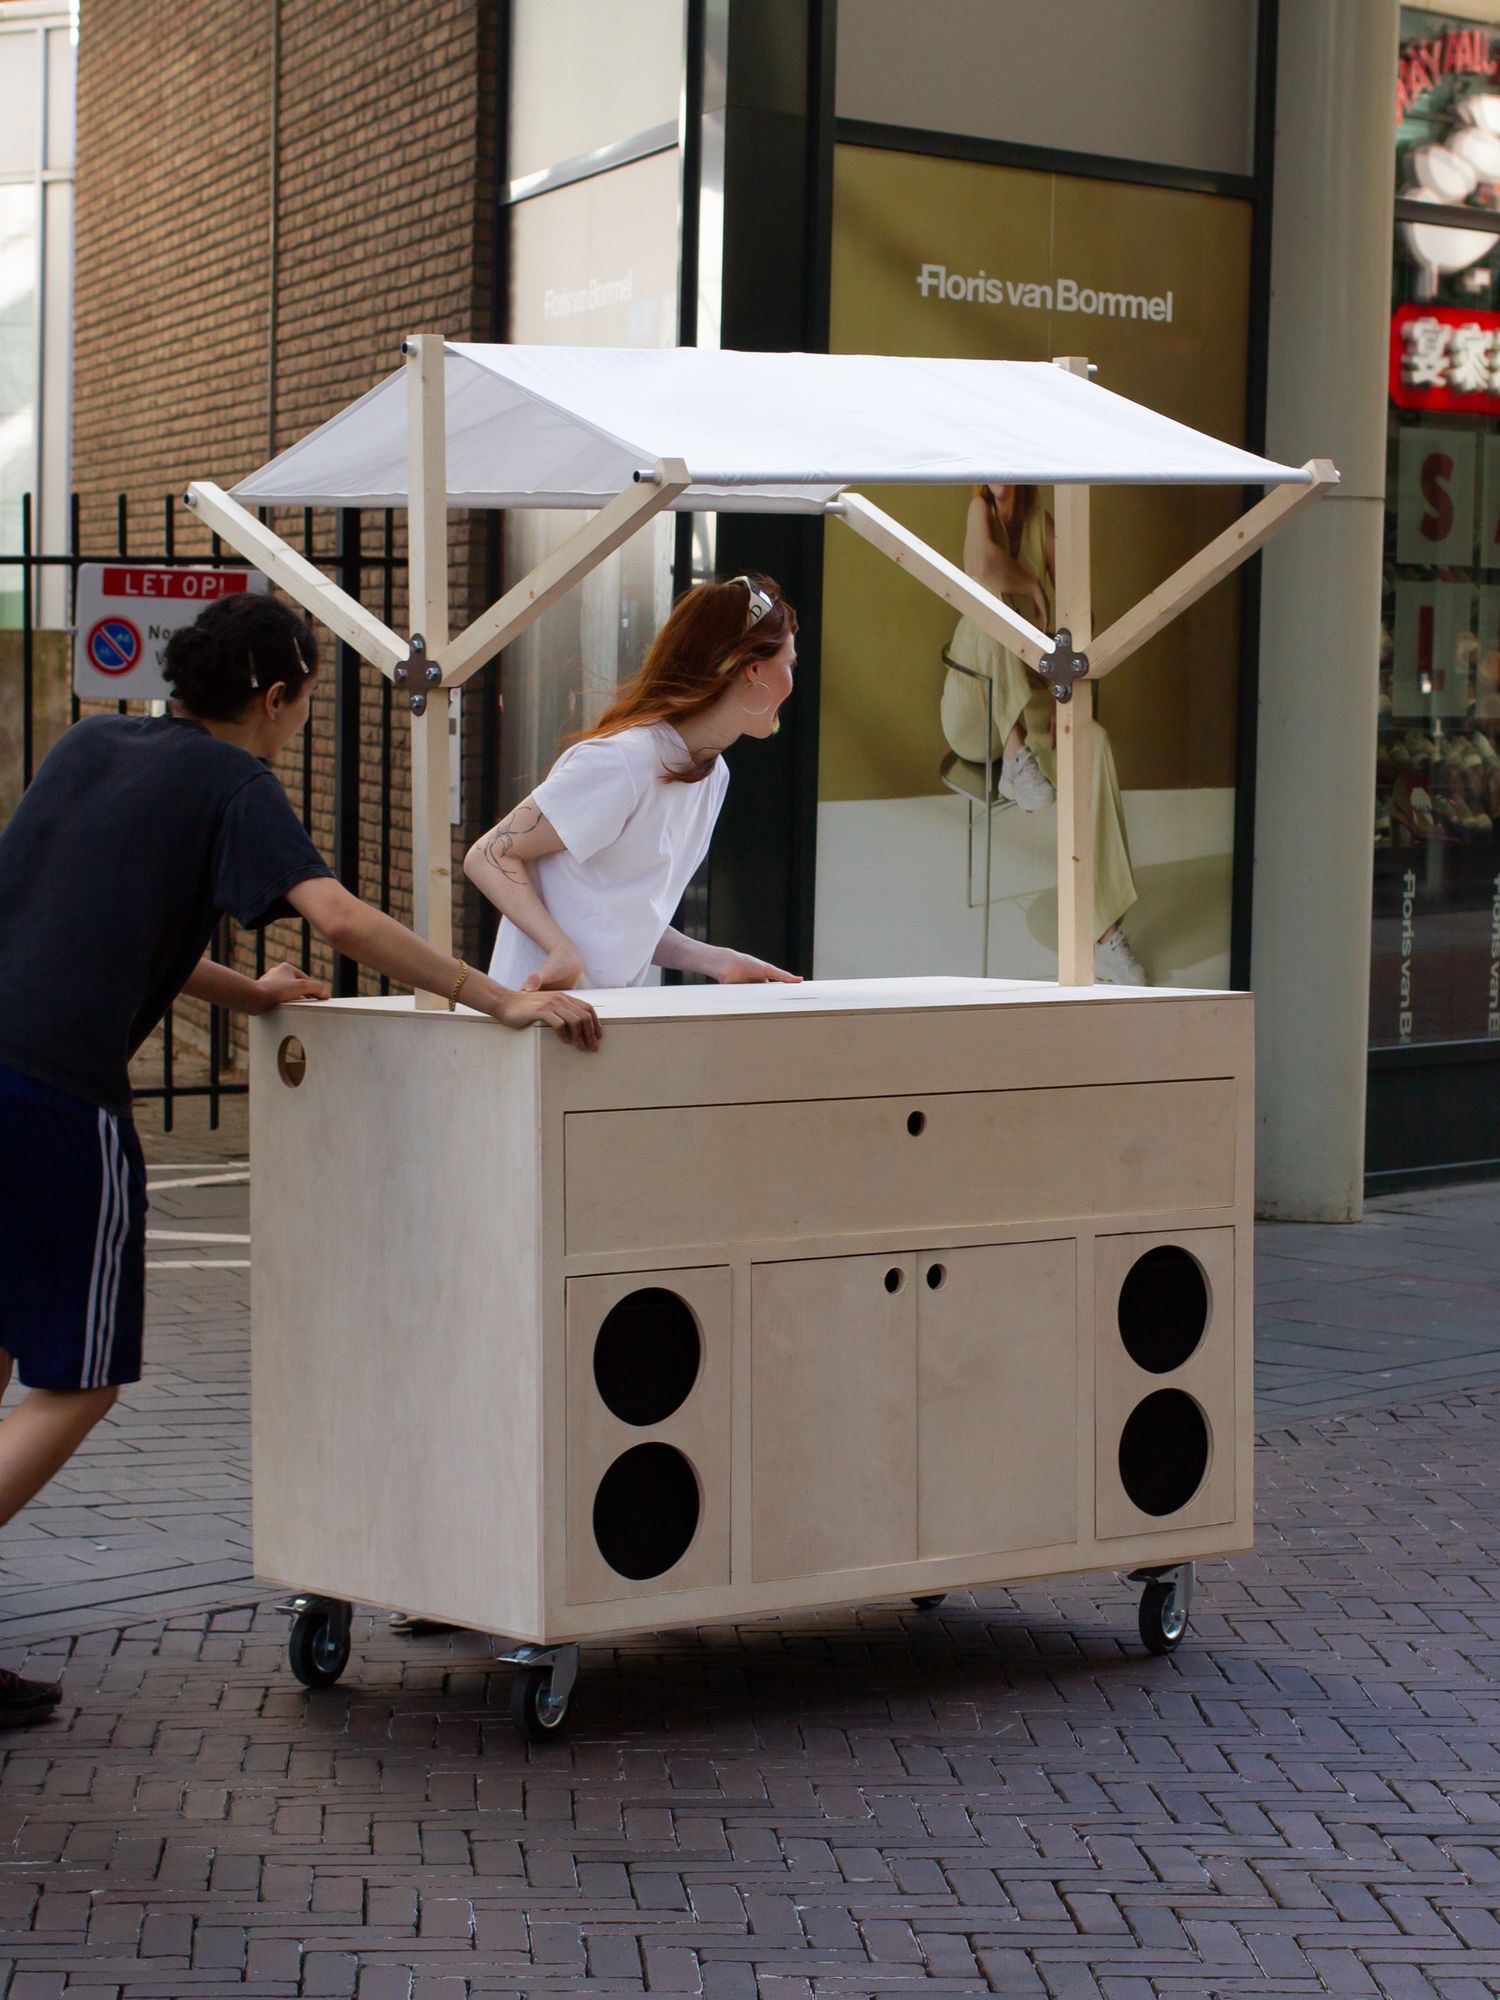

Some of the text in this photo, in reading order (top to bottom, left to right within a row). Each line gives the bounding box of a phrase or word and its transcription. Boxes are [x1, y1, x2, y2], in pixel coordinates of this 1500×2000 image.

[916, 263, 1173, 323] Floris van Bommel
[125, 573, 225, 597] LET OP!
[1402, 868, 1415, 956] Floris
[1400, 958, 1411, 1008] van
